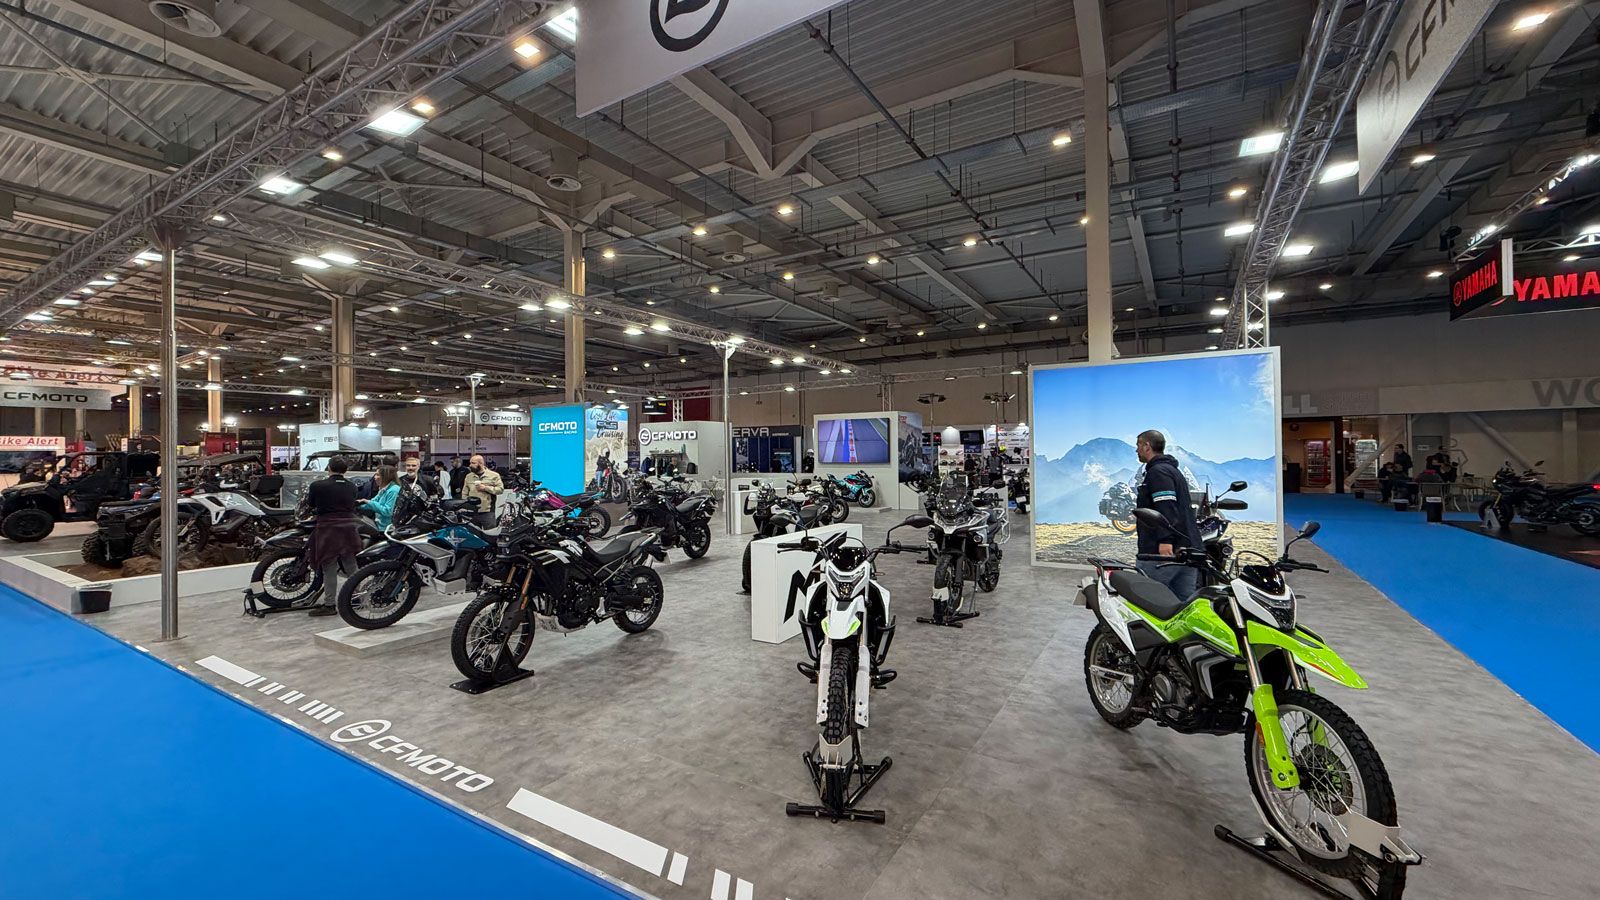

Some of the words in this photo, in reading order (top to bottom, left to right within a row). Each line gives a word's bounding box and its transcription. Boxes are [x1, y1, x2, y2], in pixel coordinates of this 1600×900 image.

[1405, 0, 1455, 81] CF
[1462, 260, 1498, 300] YAMAHA
[4, 391, 88, 403] CFMOTO
[538, 421, 577, 431] CFMOTO
[0, 437, 21, 445] ike
[28, 437, 58, 445] Alert
[651, 430, 697, 441] CFMOTO
[368, 735, 495, 793] CFMOTO
